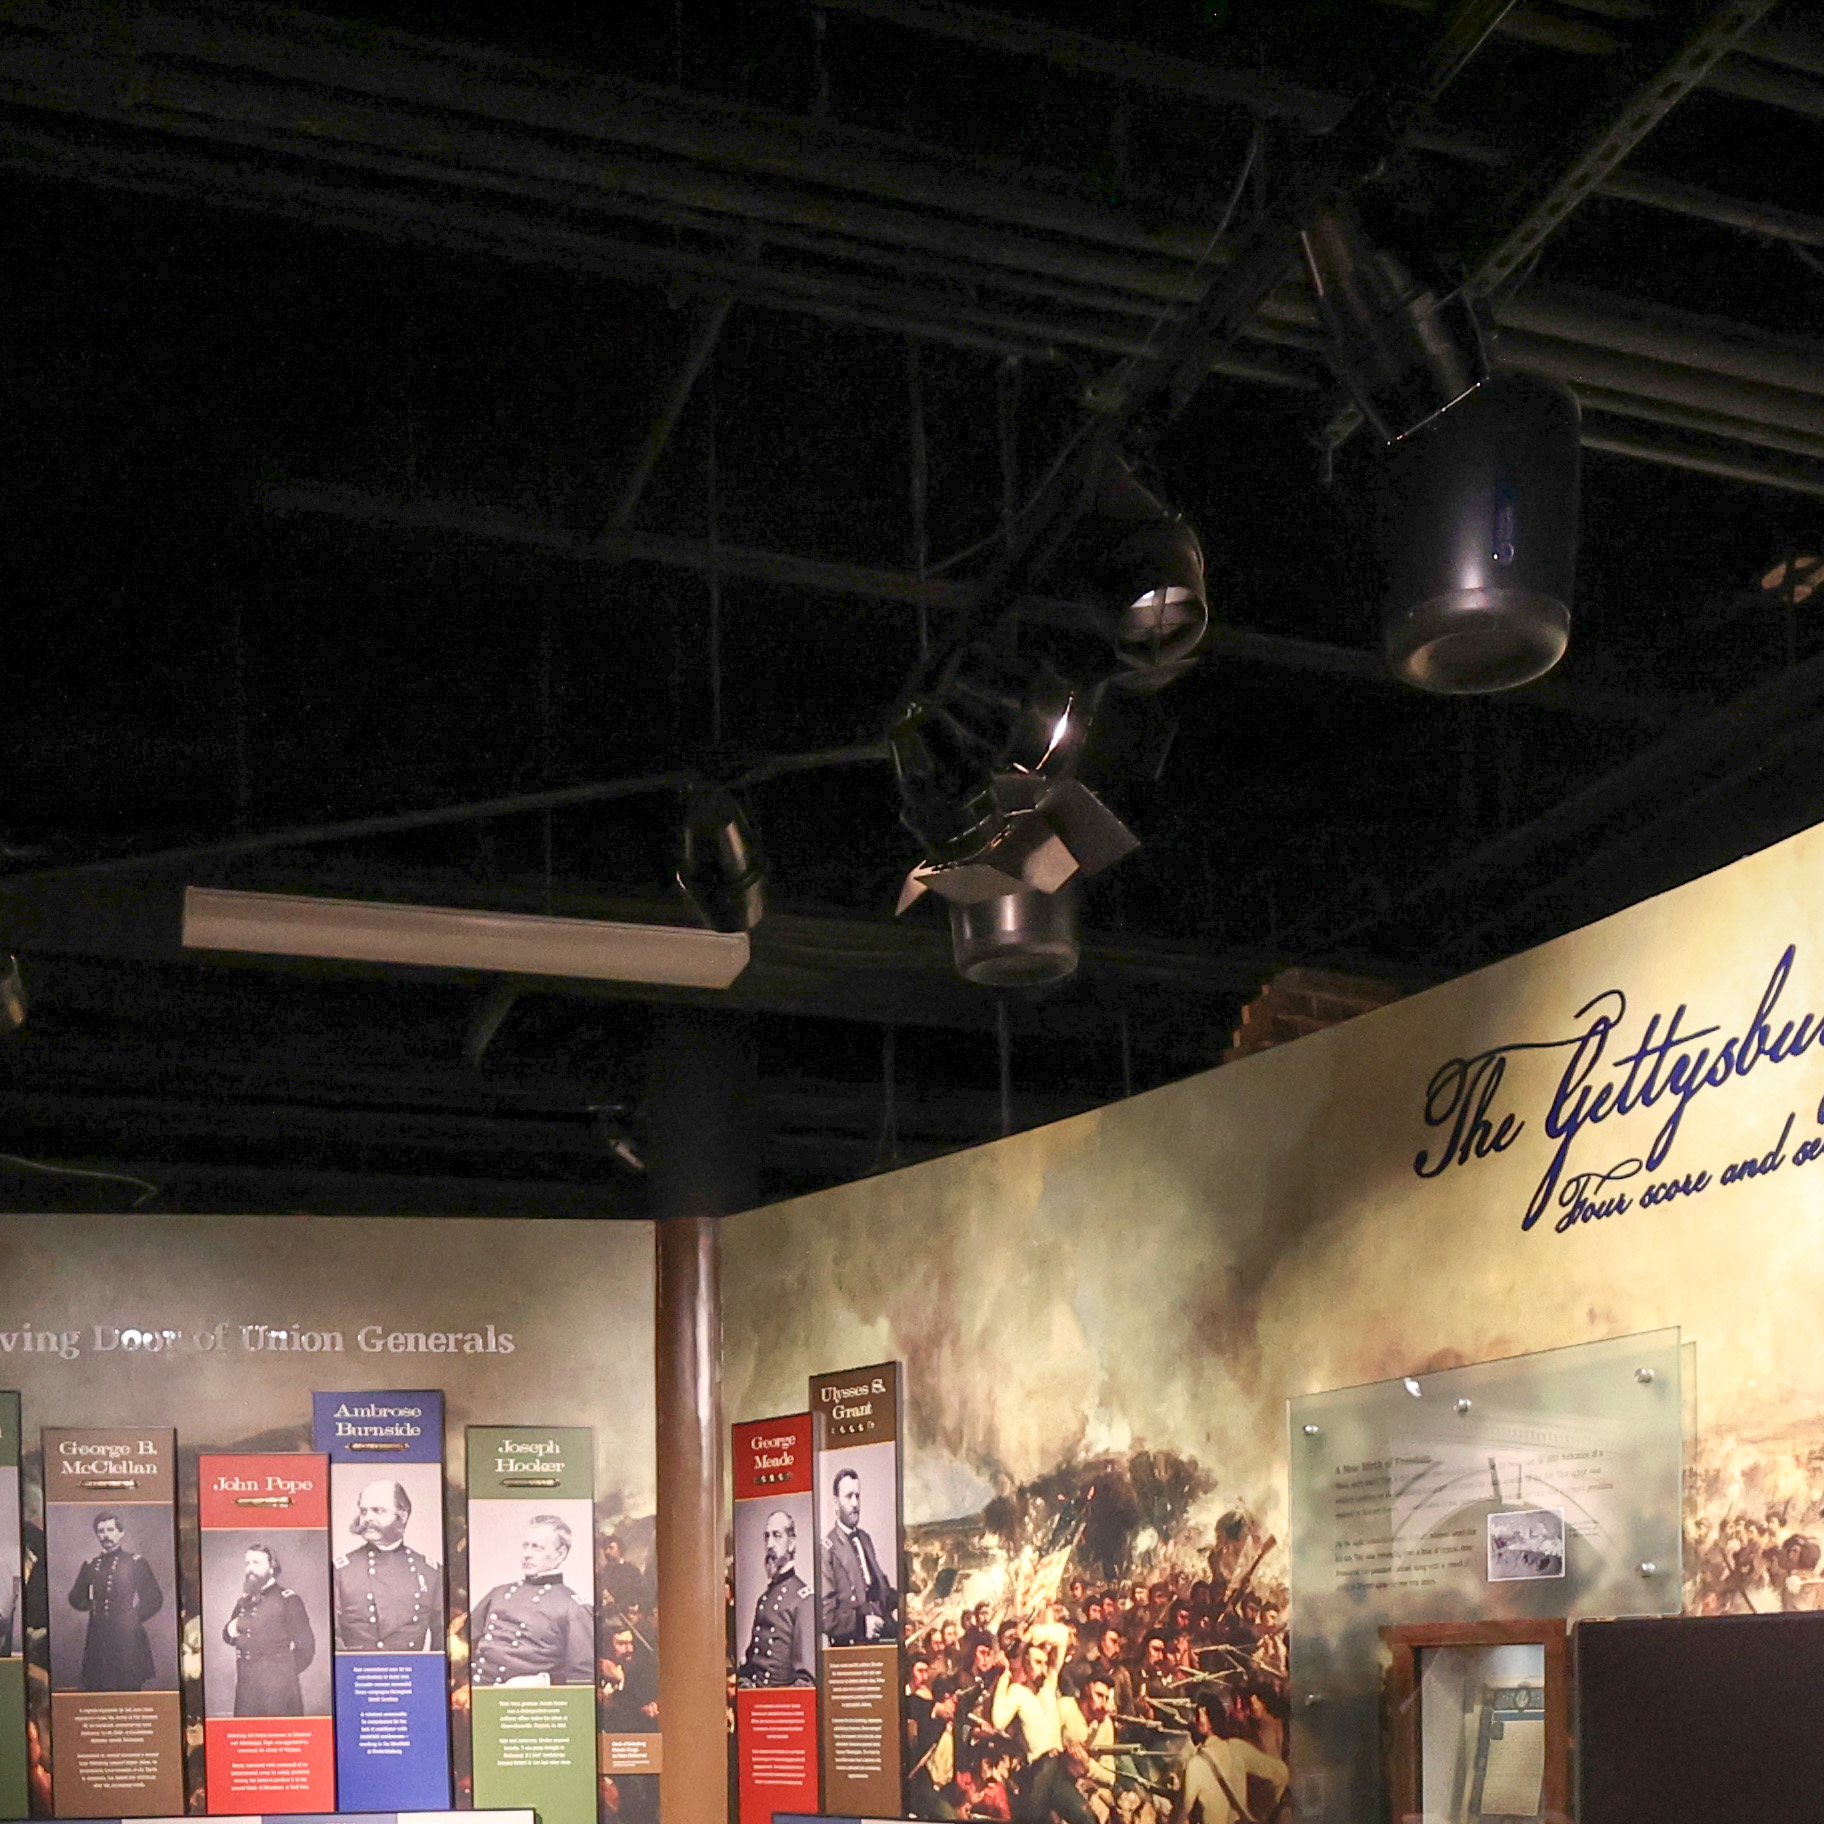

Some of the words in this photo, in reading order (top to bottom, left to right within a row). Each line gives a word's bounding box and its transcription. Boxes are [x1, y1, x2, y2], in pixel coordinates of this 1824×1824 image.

[1414, 1039, 1524, 1178] The
[1556, 1158, 1643, 1234] Four
[1640, 1172, 1712, 1209] score
[1721, 1113, 1790, 1188] and
[94, 1325, 182, 1352] Door
[193, 1323, 228, 1352] of
[242, 1325, 344, 1352] Union
[358, 1325, 515, 1353] Generals
[821, 1385, 869, 1403] Ulysses
[871, 1378, 886, 1394] S.
[333, 1404, 421, 1418] Ambrose
[832, 1402, 873, 1420] Grant
[336, 1423, 421, 1437] Burnside
[59, 1441, 130, 1456] George
[138, 1442, 157, 1455] B.
[498, 1439, 560, 1455] Joseph
[751, 1435, 796, 1450] George
[61, 1460, 158, 1474] McClellan
[495, 1458, 565, 1472] Hooker
[754, 1452, 794, 1470] Meade
[213, 1477, 259, 1491] John
[266, 1477, 313, 1491] Pope
